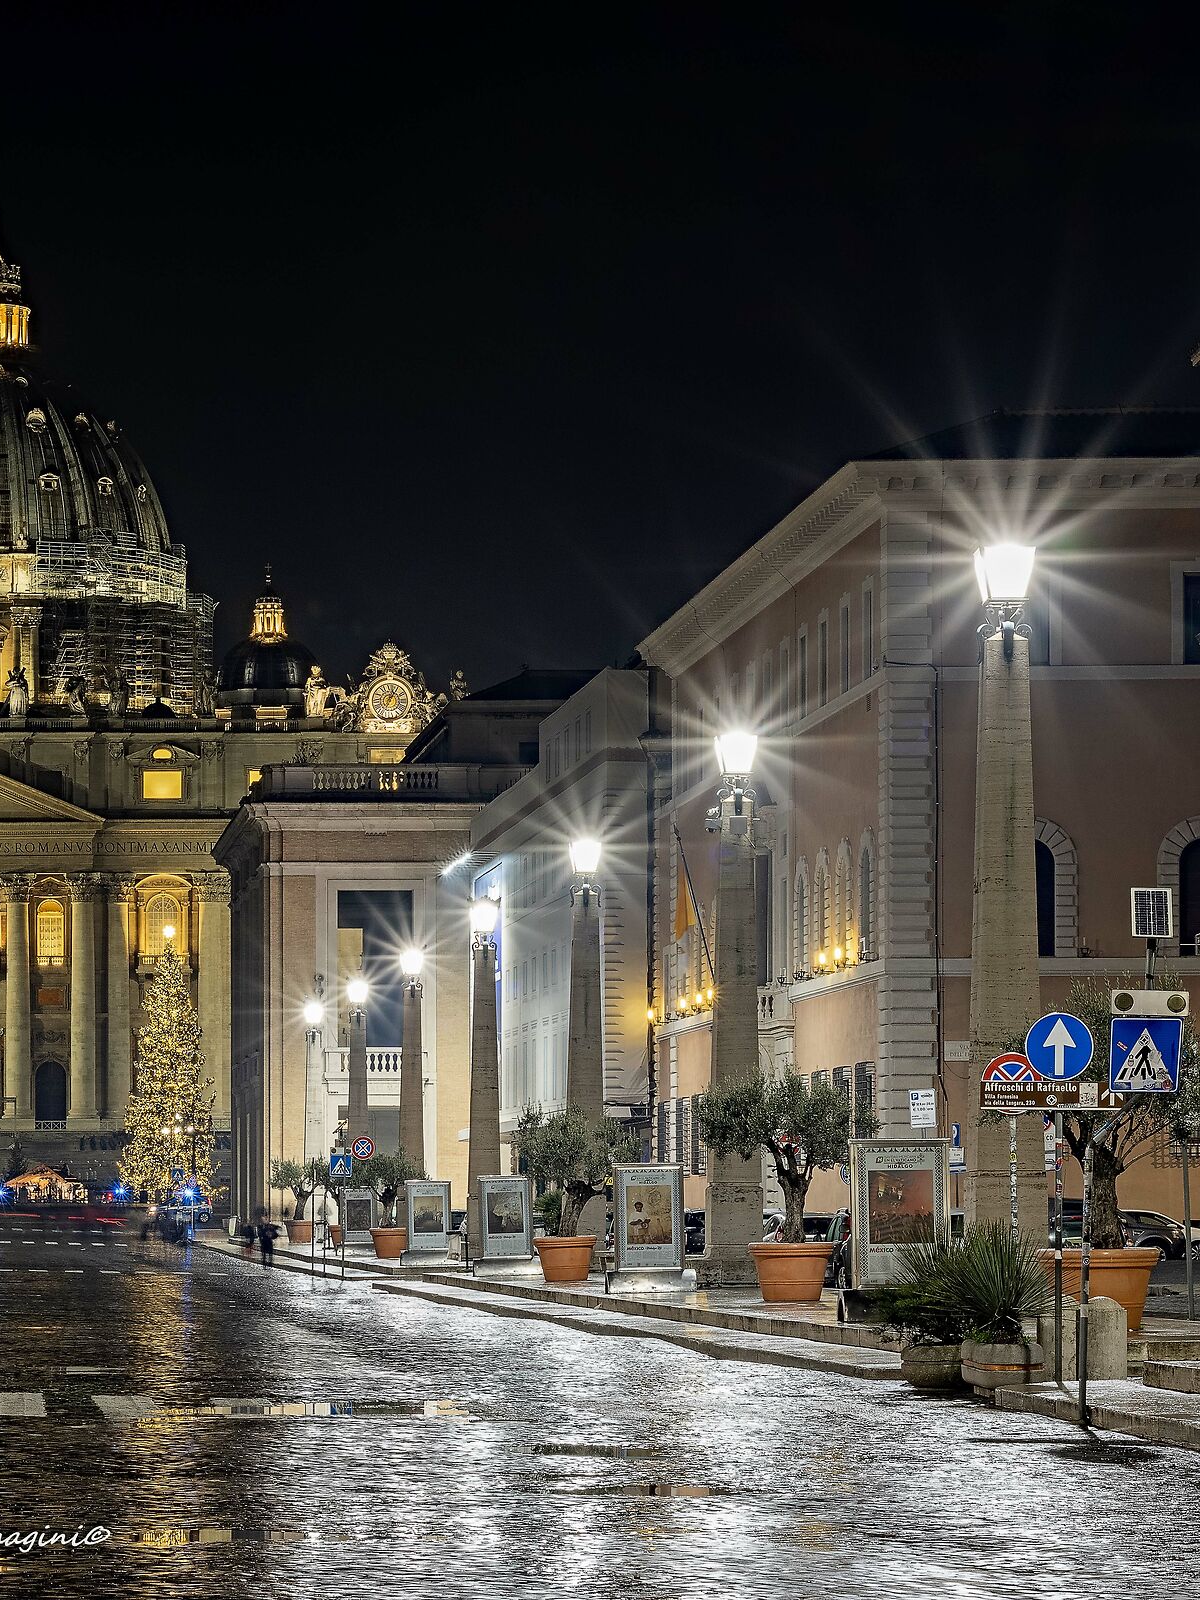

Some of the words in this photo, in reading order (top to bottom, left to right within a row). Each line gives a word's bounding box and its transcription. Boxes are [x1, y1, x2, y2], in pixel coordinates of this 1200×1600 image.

[15, 842, 92, 853] ROMANVS
[96, 841, 136, 853] PONT
[137, 841, 170, 853] MAX
[984, 1083, 1024, 1092] Affreschi
[1025, 1083, 1034, 1092] di
[1037, 1083, 1077, 1092] Raffaello
